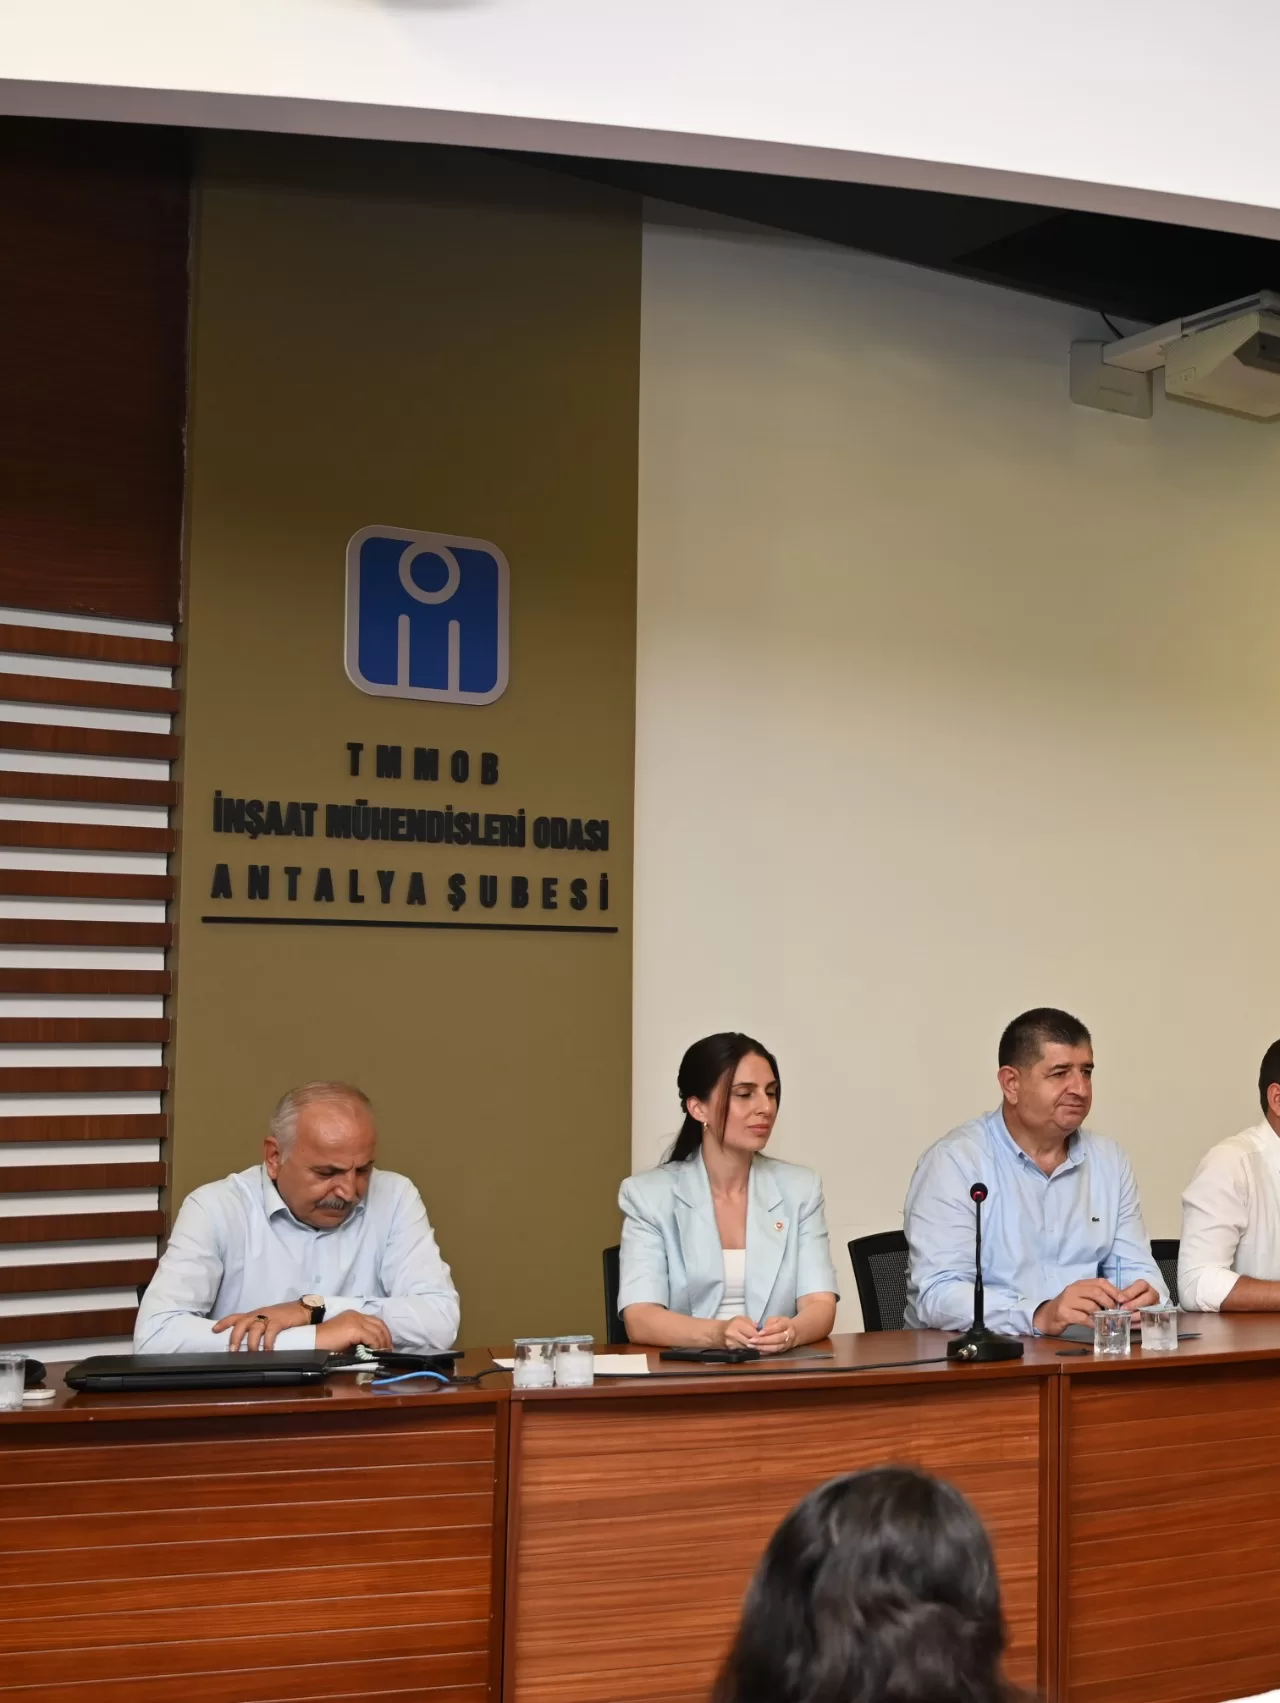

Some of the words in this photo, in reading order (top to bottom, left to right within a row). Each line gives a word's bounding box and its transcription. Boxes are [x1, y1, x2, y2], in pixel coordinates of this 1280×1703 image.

[346, 742, 499, 785] TMMOB
[213, 790, 318, 840] İNŞAAT
[325, 799, 526, 848] MÜHENDİSLERİ
[533, 816, 610, 851] ODASI
[210, 863, 426, 905] ANTALYA
[447, 872, 609, 911] ŞUBESİ
